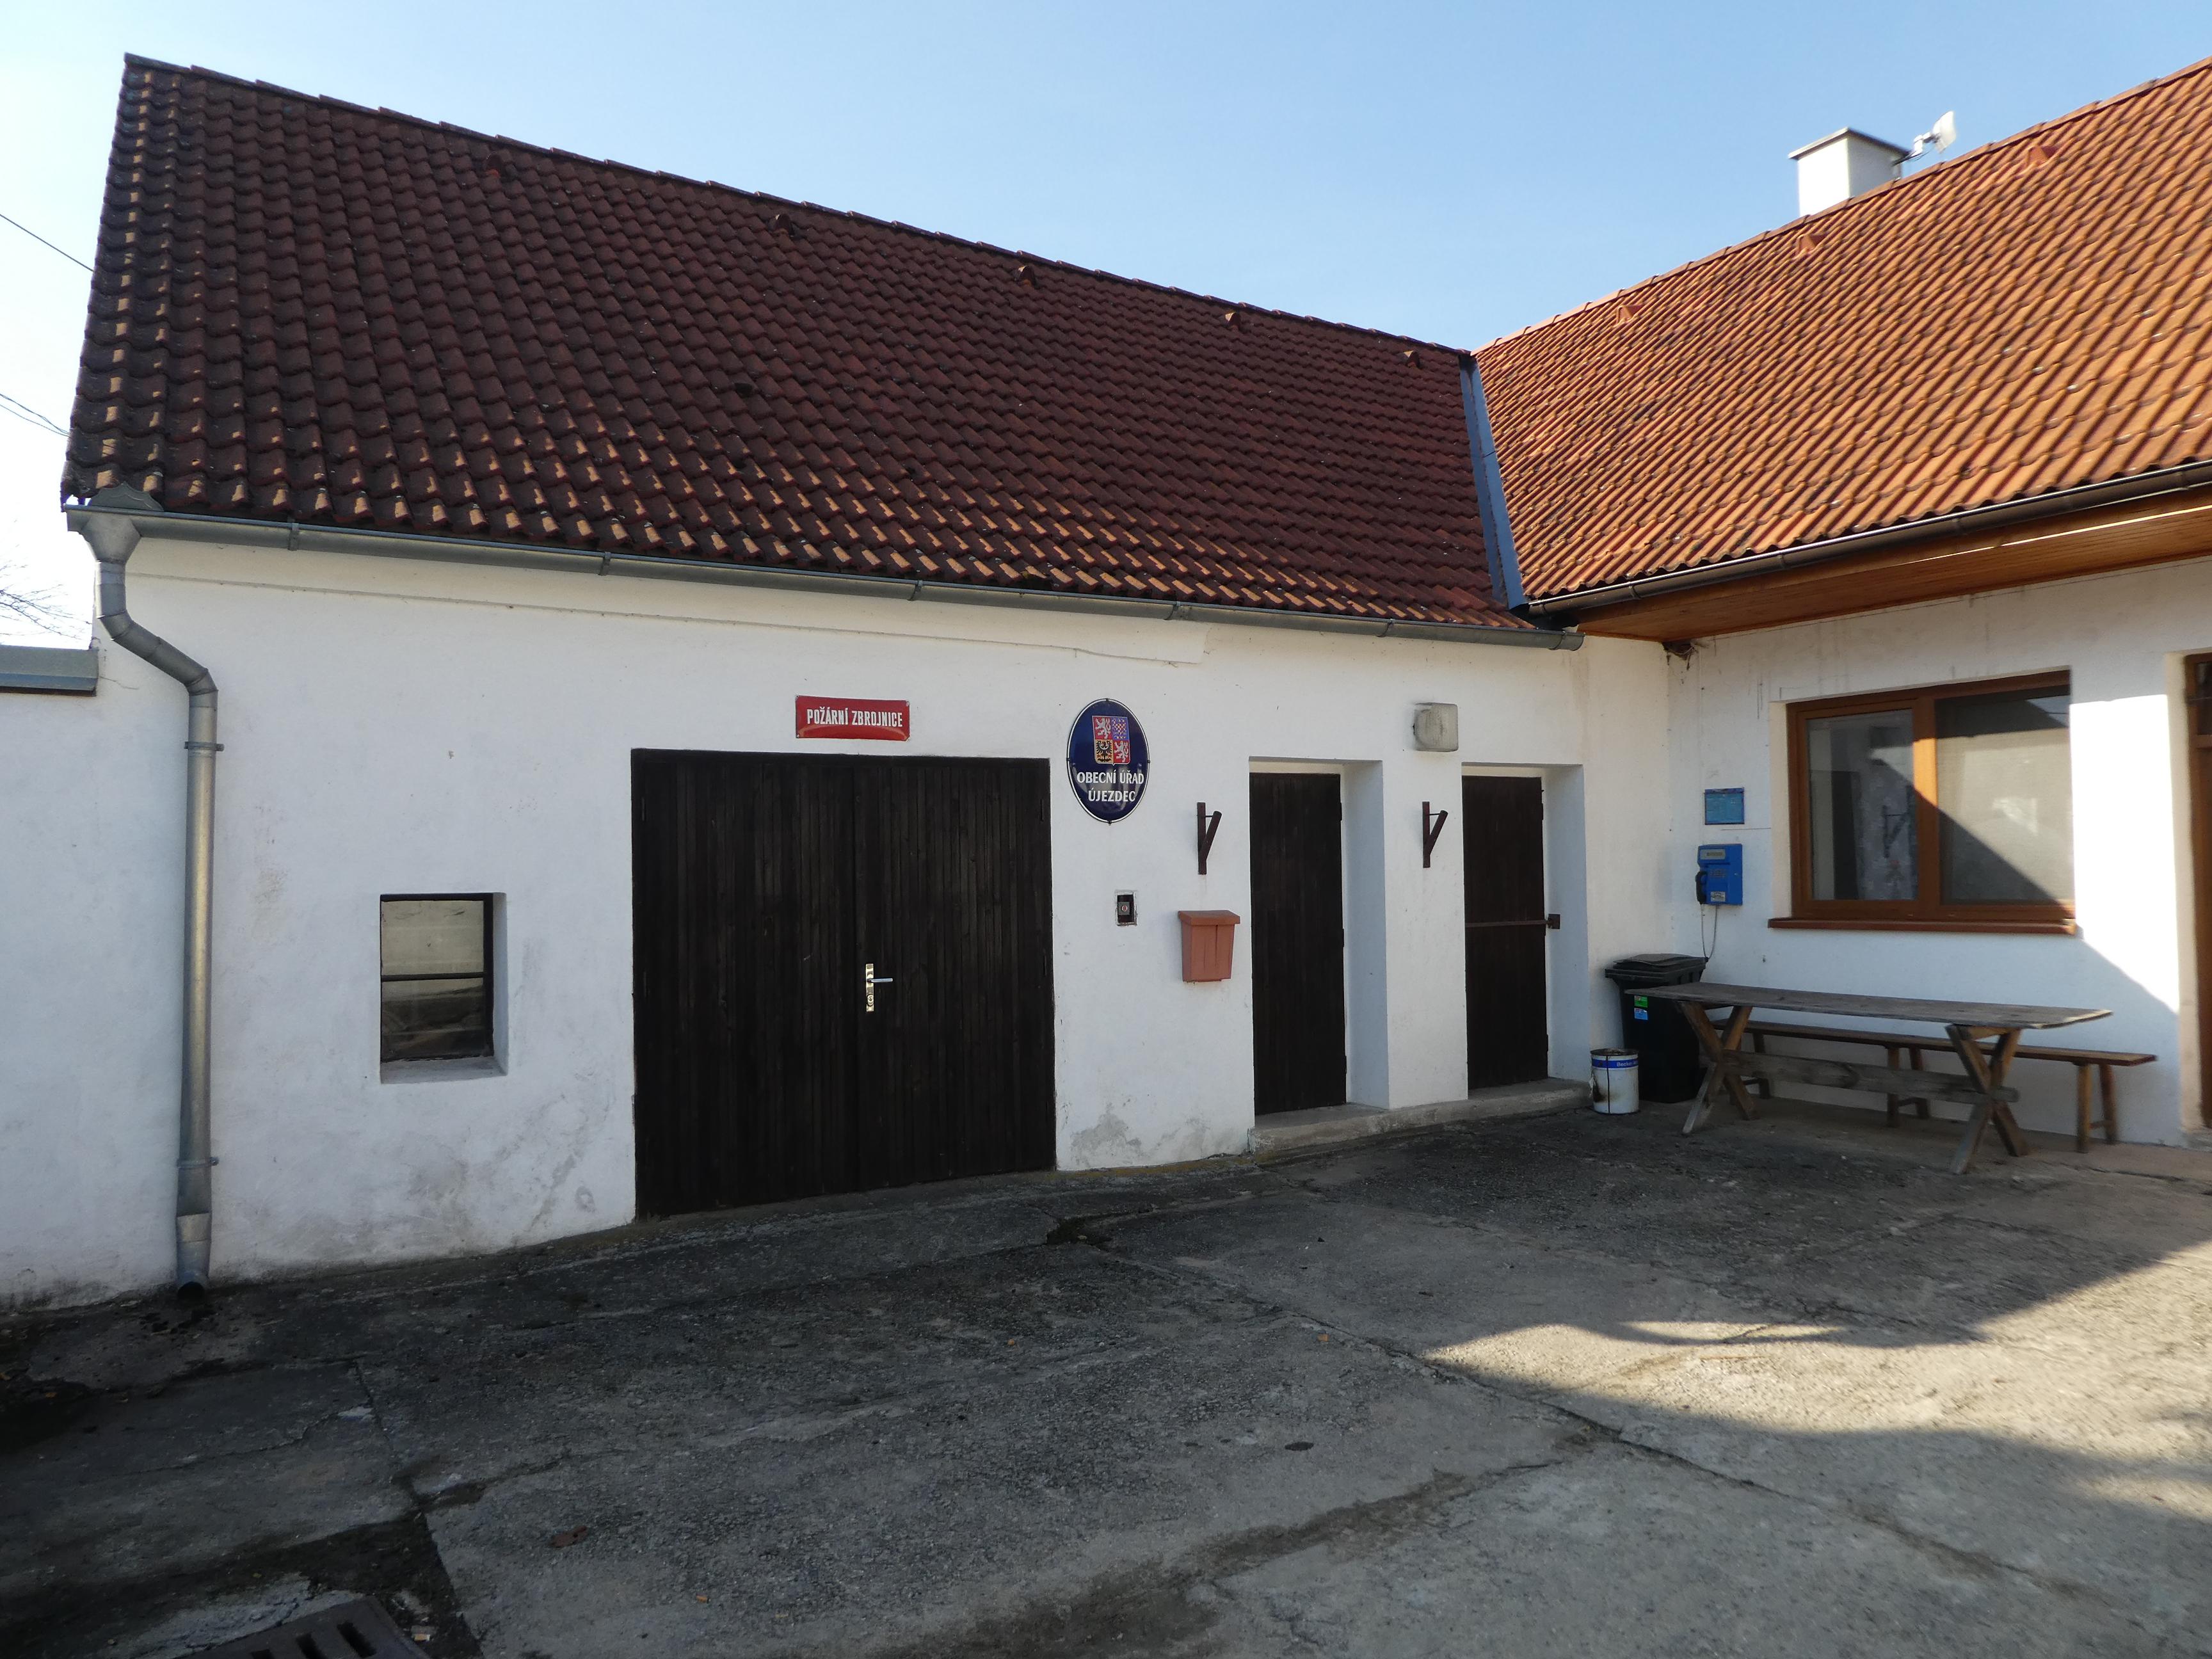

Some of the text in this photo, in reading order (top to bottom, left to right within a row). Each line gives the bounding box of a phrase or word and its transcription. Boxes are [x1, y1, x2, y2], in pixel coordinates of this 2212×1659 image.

[806, 706, 902, 726] POŽÁRNÍ ZBROJNICE
[1077, 769, 1144, 784] OBECNÍ ÚŘAD
[1088, 787, 1136, 802] ÚJEZDEC
